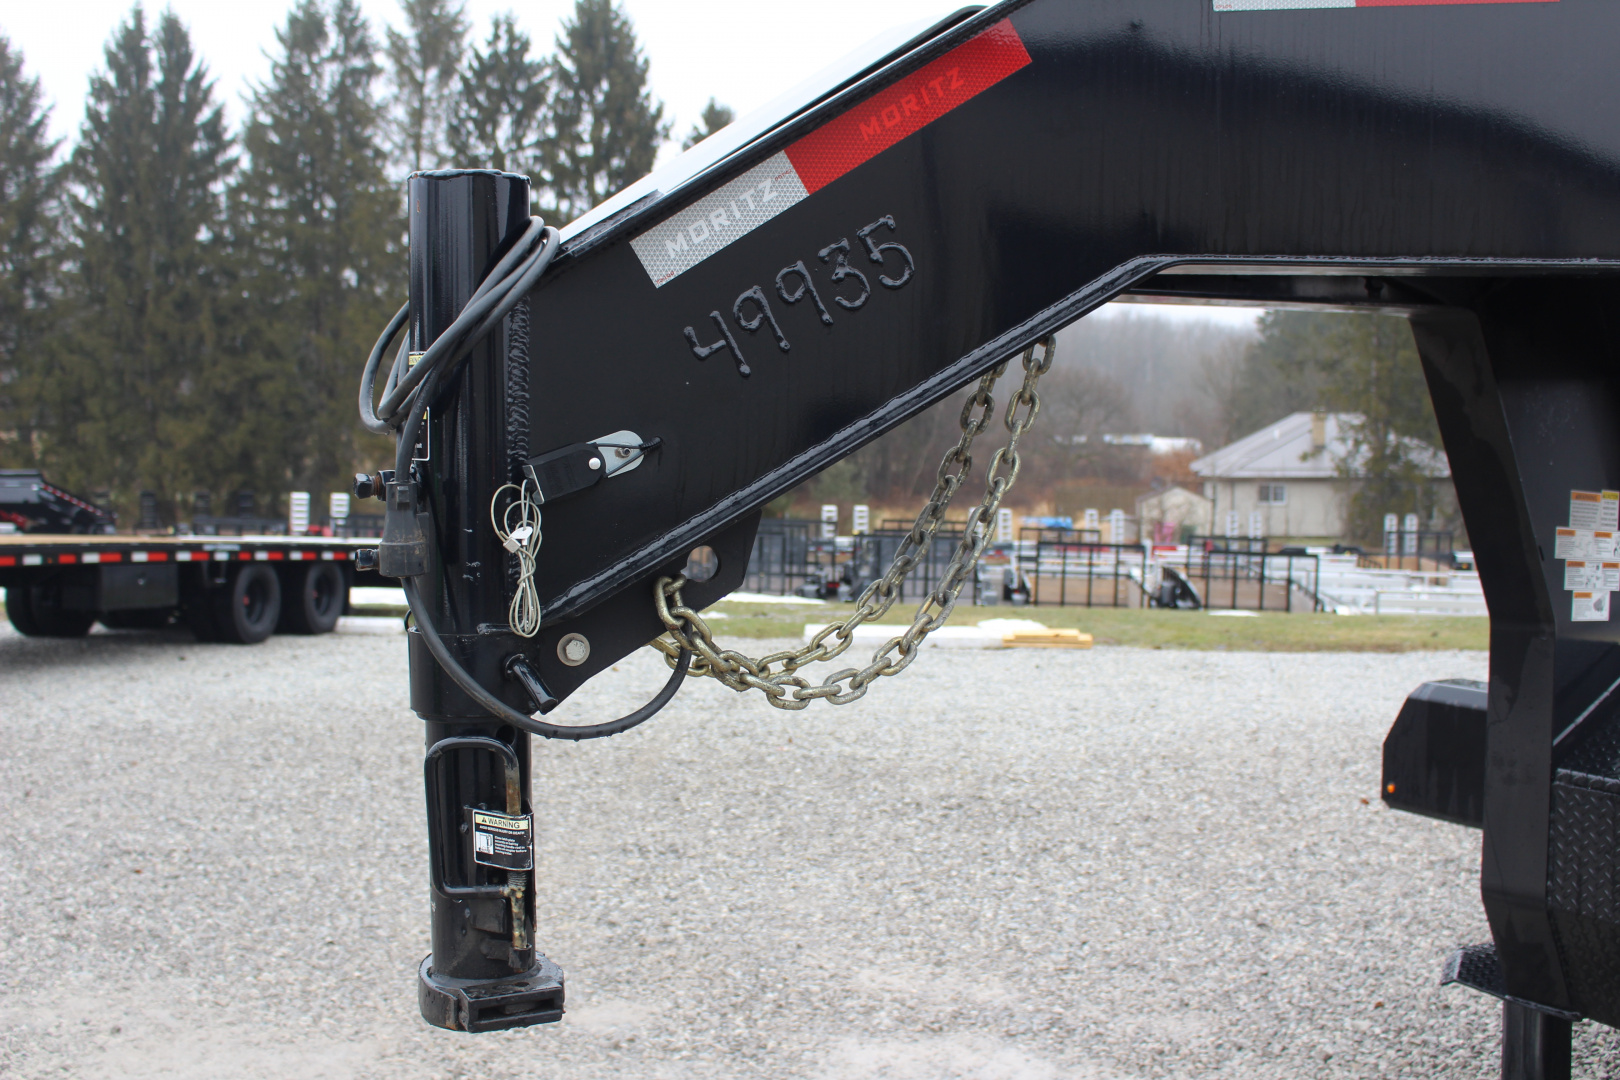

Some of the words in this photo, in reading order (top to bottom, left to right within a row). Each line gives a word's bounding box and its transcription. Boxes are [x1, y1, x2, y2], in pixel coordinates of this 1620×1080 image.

[858, 66, 965, 143] MORITZ
[664, 177, 779, 260] MORITZ
[683, 214, 915, 377] 49935
[488, 817, 520, 829] WARNING
